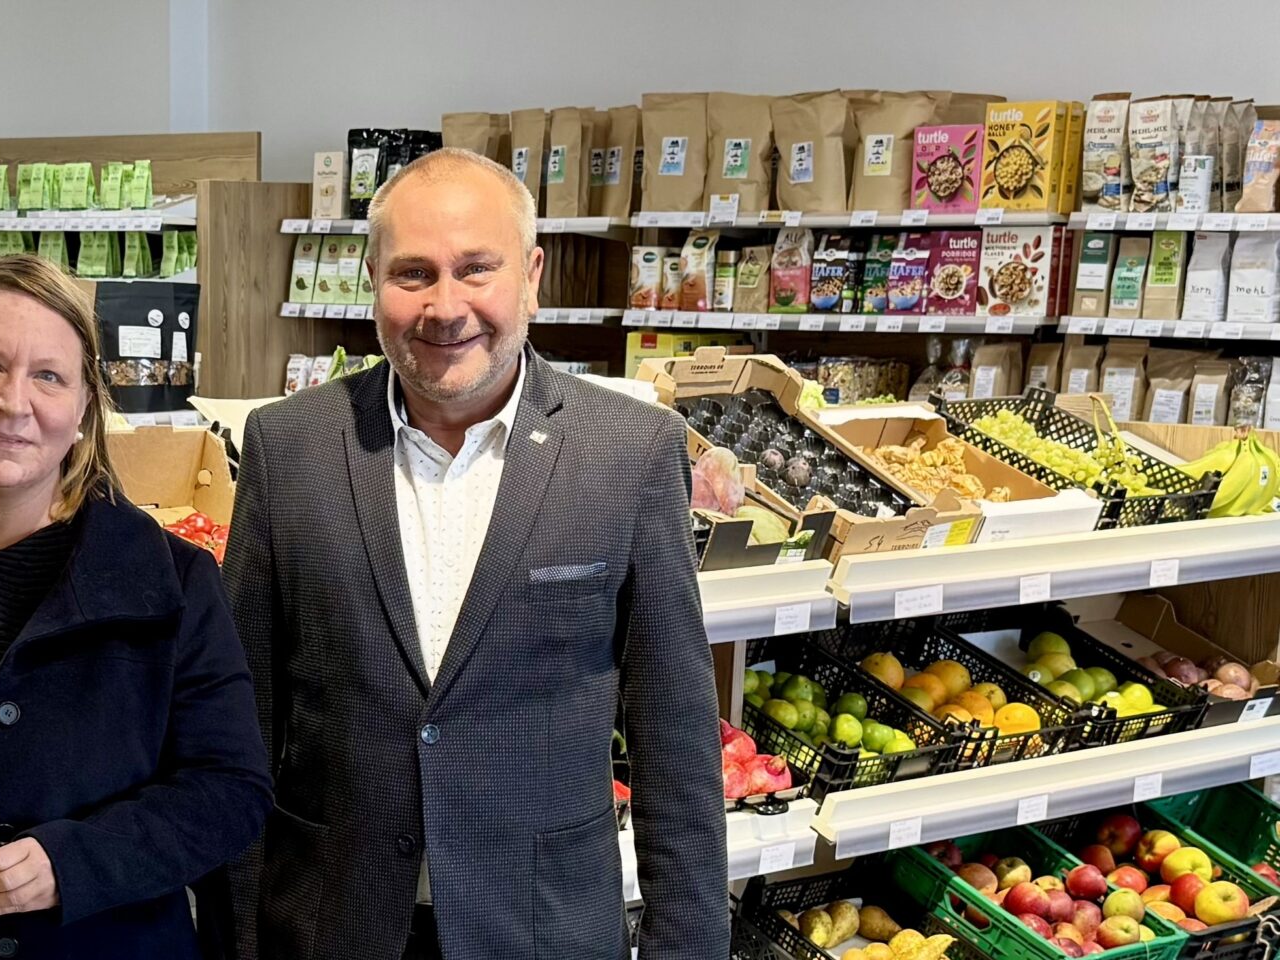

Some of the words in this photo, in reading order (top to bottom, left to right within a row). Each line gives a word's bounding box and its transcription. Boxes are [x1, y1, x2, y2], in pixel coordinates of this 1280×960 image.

[990, 109, 1023, 122] turtle
[988, 123, 1016, 131] HONEY
[917, 130, 949, 145] turtle
[949, 237, 977, 249] turtle
[986, 231, 1018, 244] turtle
[941, 250, 976, 258] PORRIDGE
[812, 266, 844, 277] HAFER
